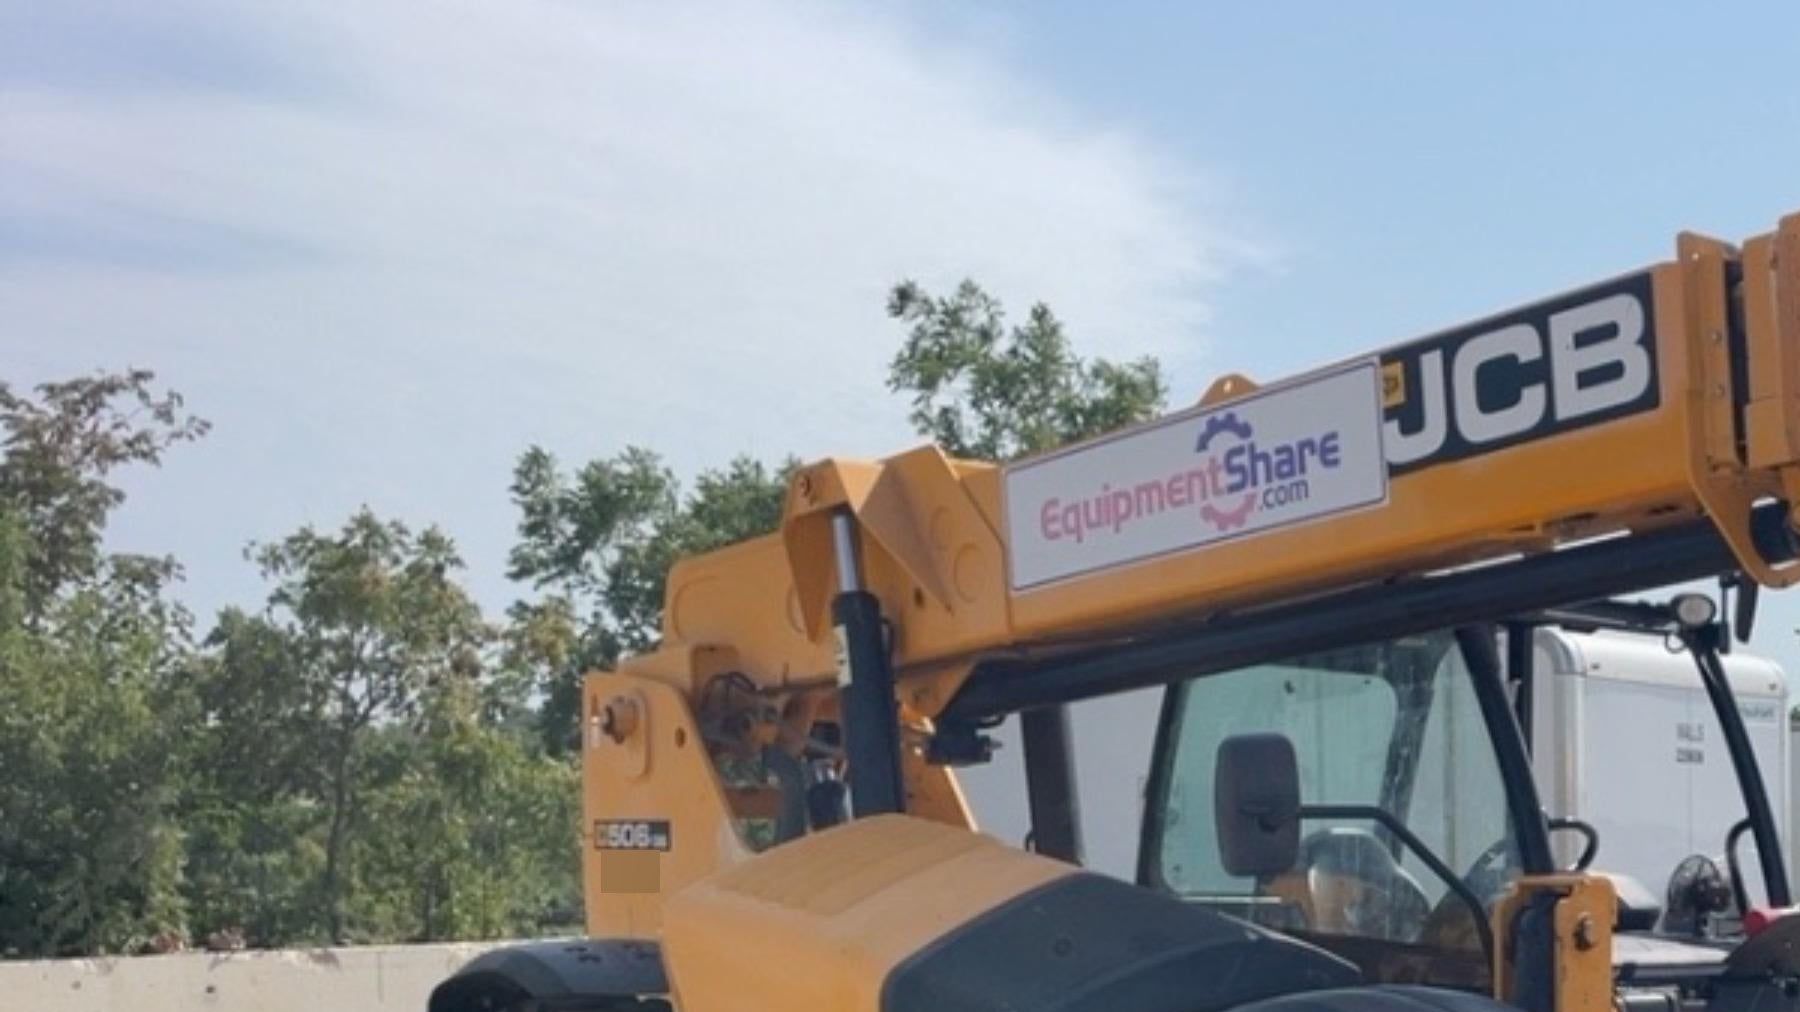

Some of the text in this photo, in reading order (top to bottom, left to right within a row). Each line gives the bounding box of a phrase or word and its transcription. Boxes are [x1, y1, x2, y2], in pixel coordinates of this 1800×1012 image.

[1382, 293, 1651, 464] JCB
[1041, 432, 1340, 543] EquipmentShare
[1259, 479, 1309, 512] .com
